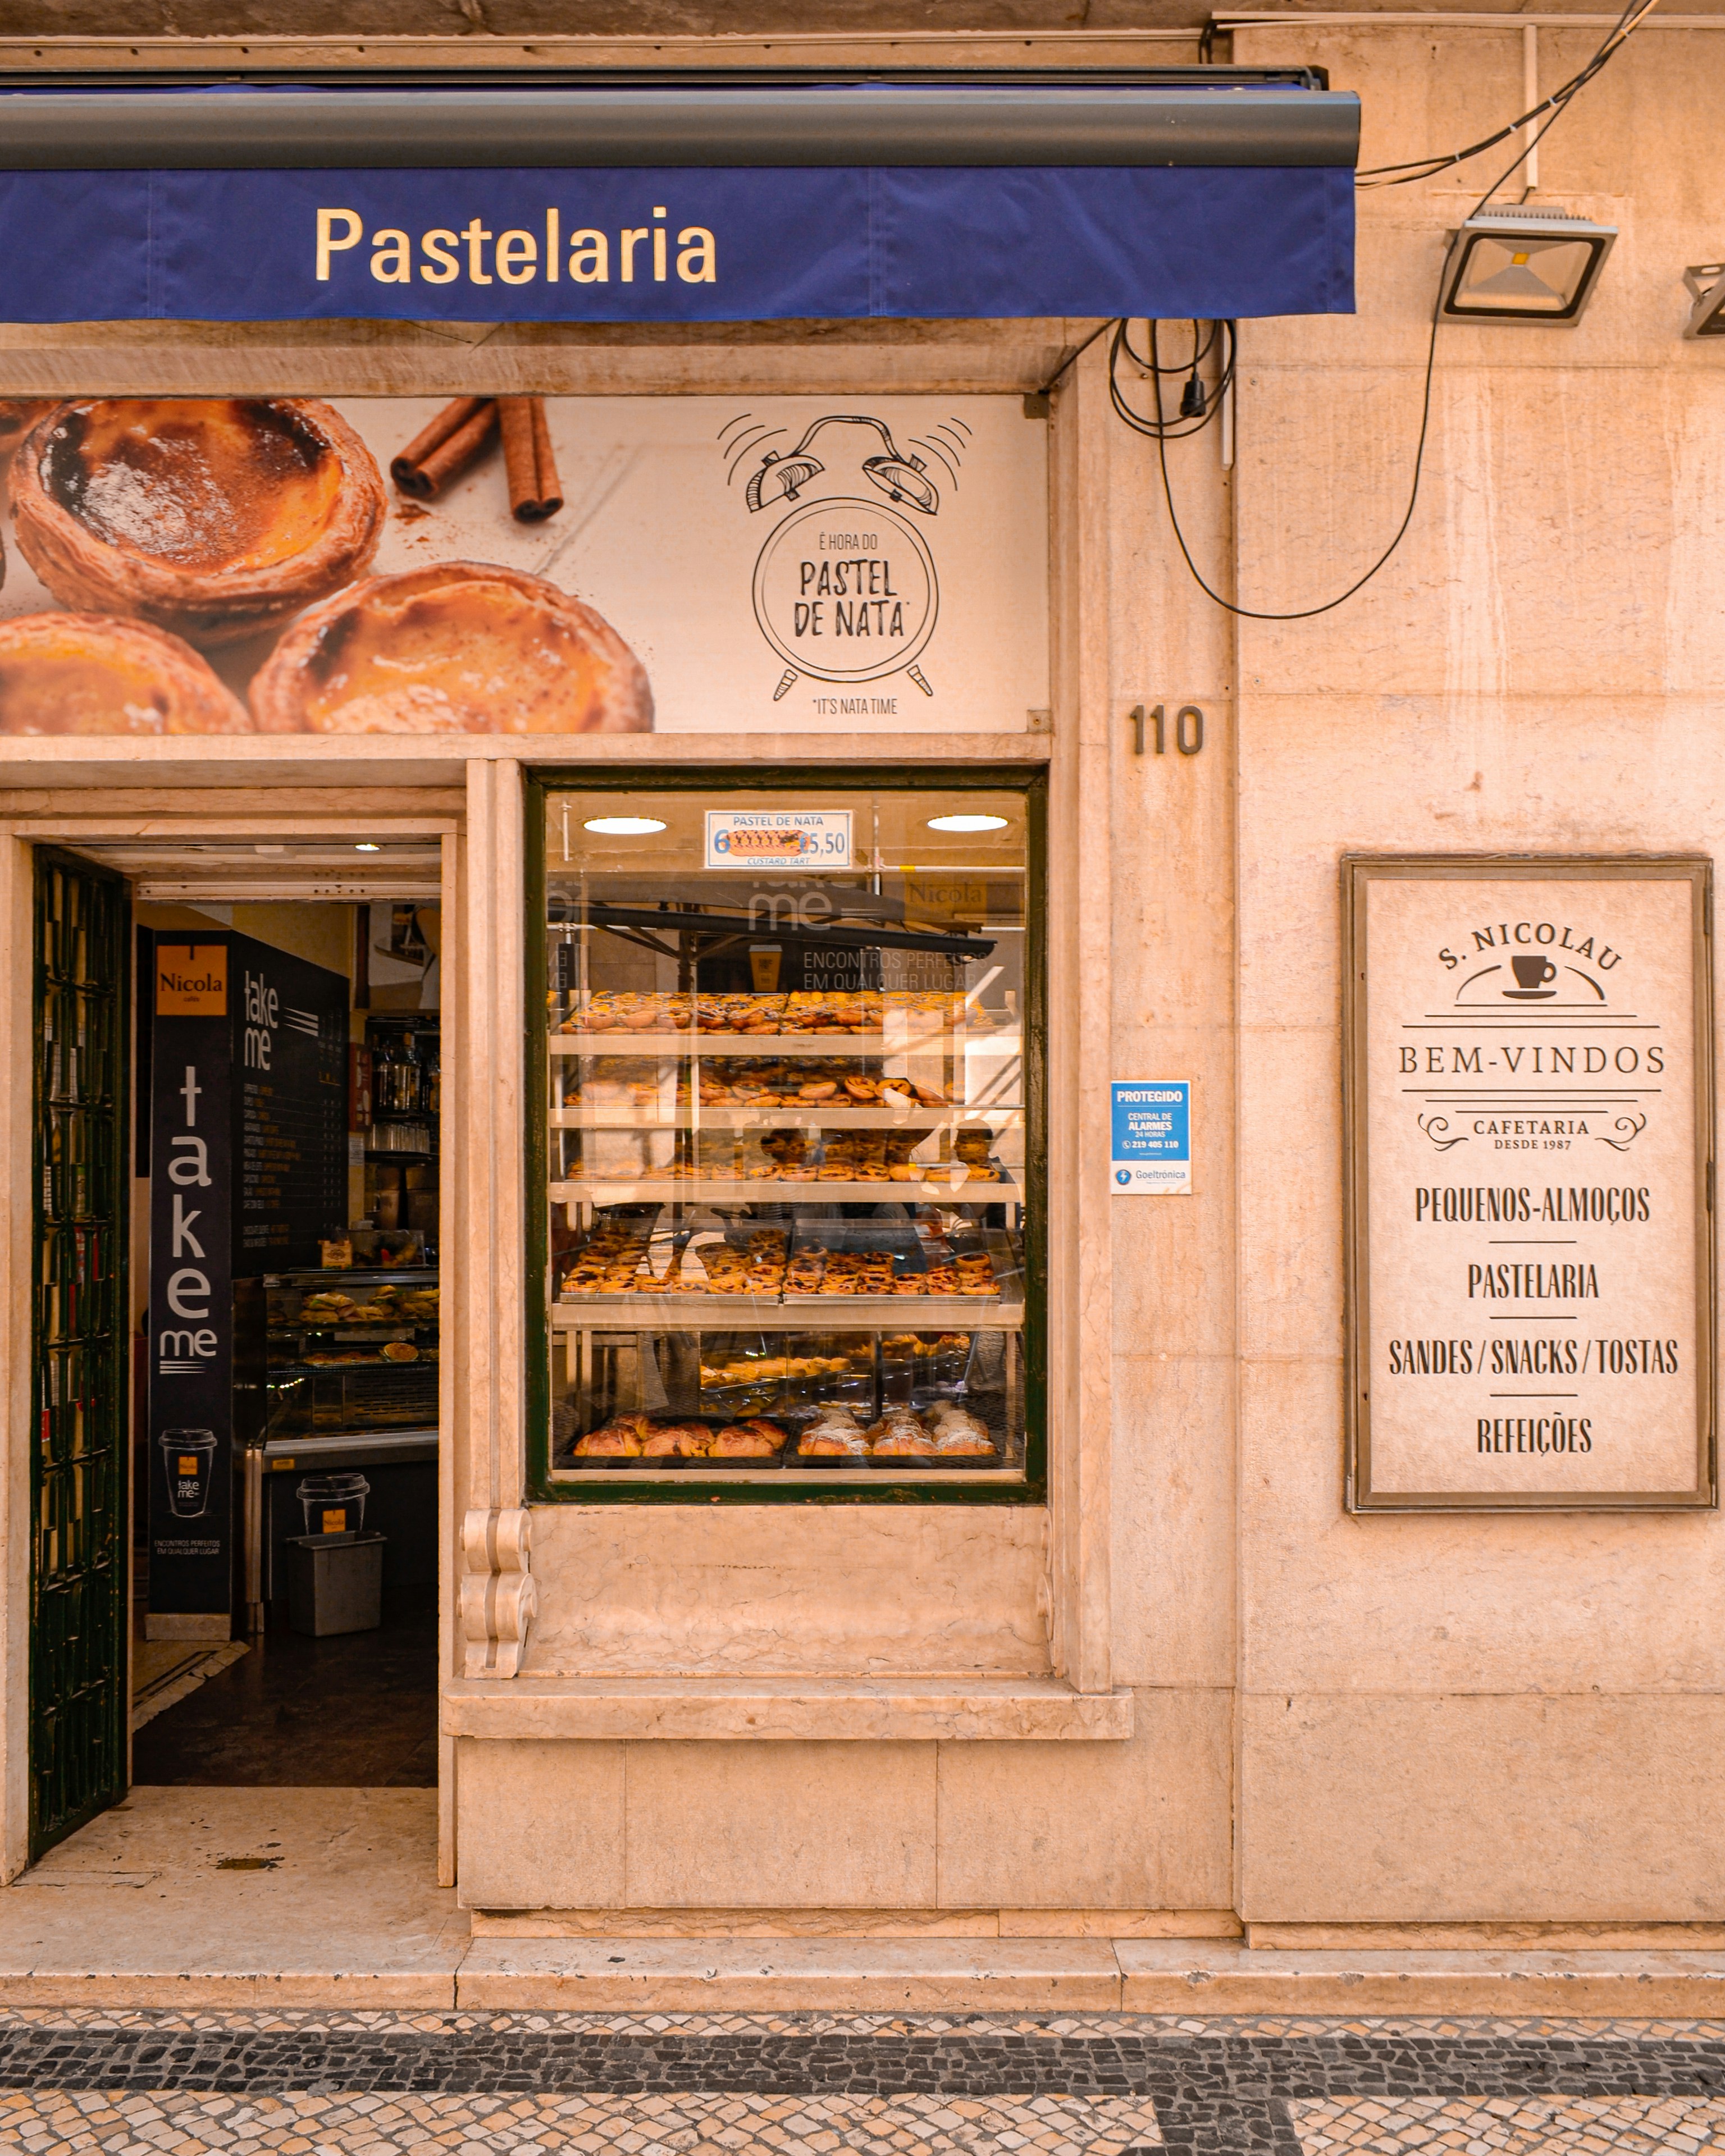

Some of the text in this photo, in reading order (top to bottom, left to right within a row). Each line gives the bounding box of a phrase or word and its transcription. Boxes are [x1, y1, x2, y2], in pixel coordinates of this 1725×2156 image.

[316, 206, 717, 285] Pastelaria
[829, 533, 860, 550] HORA
[862, 533, 878, 550] DO
[800, 559, 898, 596] PASTEL
[795, 601, 824, 637] DE
[840, 698, 869, 715] NATA
[871, 698, 898, 715] TIME
[1129, 704, 1203, 755] 110
[733, 816, 824, 826] PASTEL DE NATA
[714, 829, 731, 854] 6
[909, 881, 982, 903] Nicola
[748, 891, 833, 931] me
[1438, 922, 1622, 971] S. NICOLAU
[804, 952, 901, 969] ENCONTROS
[159, 972, 223, 992] Nicola
[804, 973, 976, 990] EM QUALQUER LUGAR
[244, 970, 279, 1029] take
[244, 1027, 271, 1071] me
[1399, 1047, 1665, 1074] BEM-VINDOS
[1117, 1090, 1183, 1102] PROTEGIDO
[1128, 1112, 1173, 1121] CENTRAL DE
[1128, 1121, 1173, 1131] ALARMES
[1473, 1120, 1590, 1134] CAFETARIA
[1494, 1140, 1572, 1150] DESDE 1987
[1415, 1187, 1650, 1225] PEQUENOS-ALMOÇOS
[1467, 1263, 1600, 1298] PASTELARIA
[159, 1329, 218, 1356] me
[1477, 1412, 1592, 1457] REFEIÇÕES
[177, 1479, 200, 1490] take
[177, 1490, 195, 1499] me
